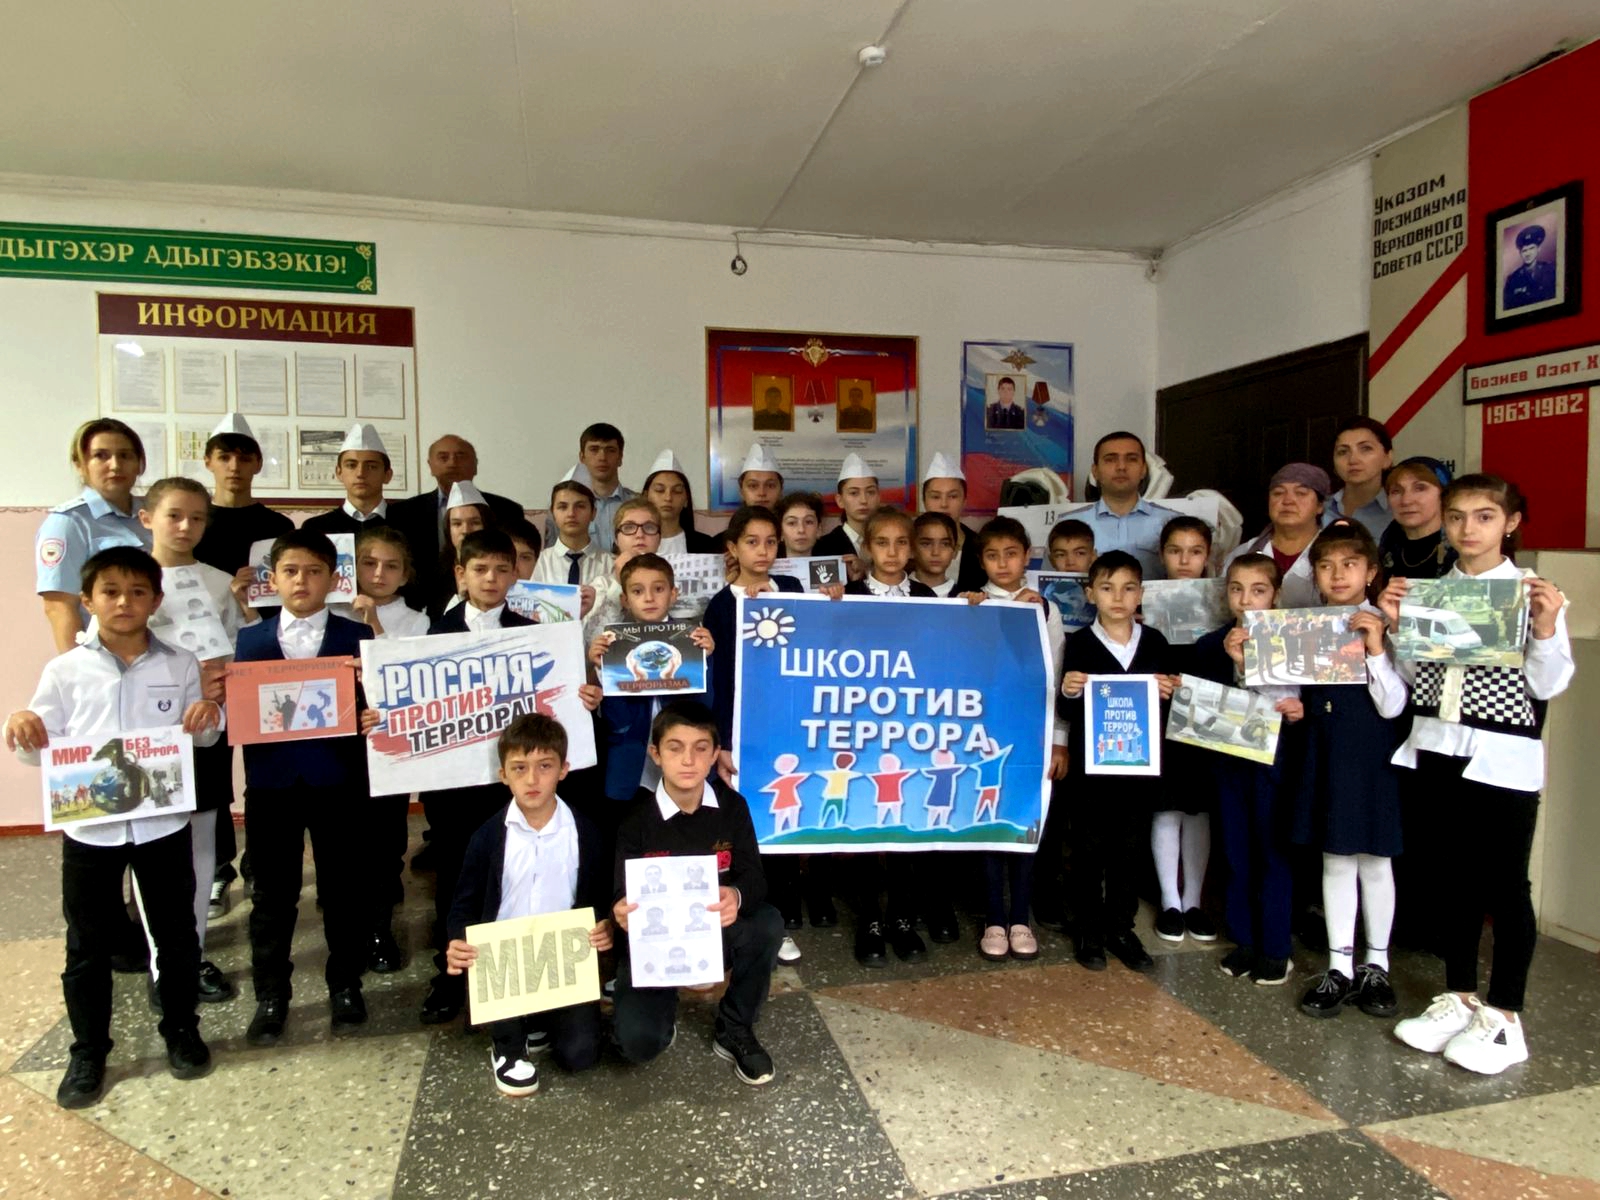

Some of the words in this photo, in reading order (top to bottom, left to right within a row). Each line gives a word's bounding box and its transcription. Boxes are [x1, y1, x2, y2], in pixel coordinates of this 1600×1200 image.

[1426, 231, 1464, 262] СССР
[137, 302, 377, 337] ИНФОРМАЦИЯ
[622, 625, 641, 634] МЫ
[643, 623, 687, 633] ПРОТИВ
[382, 652, 536, 706] РОССИЯ
[780, 647, 916, 680] ШКОЛА
[388, 685, 495, 736] ПРОТИВ
[812, 685, 984, 718] ПРОТИВ
[1104, 709, 1137, 721] ПРОТИВ
[1107, 697, 1134, 708] ШКОЛА
[801, 719, 990, 752] ТЕРРОРА
[1103, 722, 1139, 733] ТЕРРОРА
[52, 746, 93, 766] МИР
[125, 737, 151, 750] БЕЗ
[135, 744, 180, 759] ТЕРРОРА
[475, 926, 592, 1004] МИР
